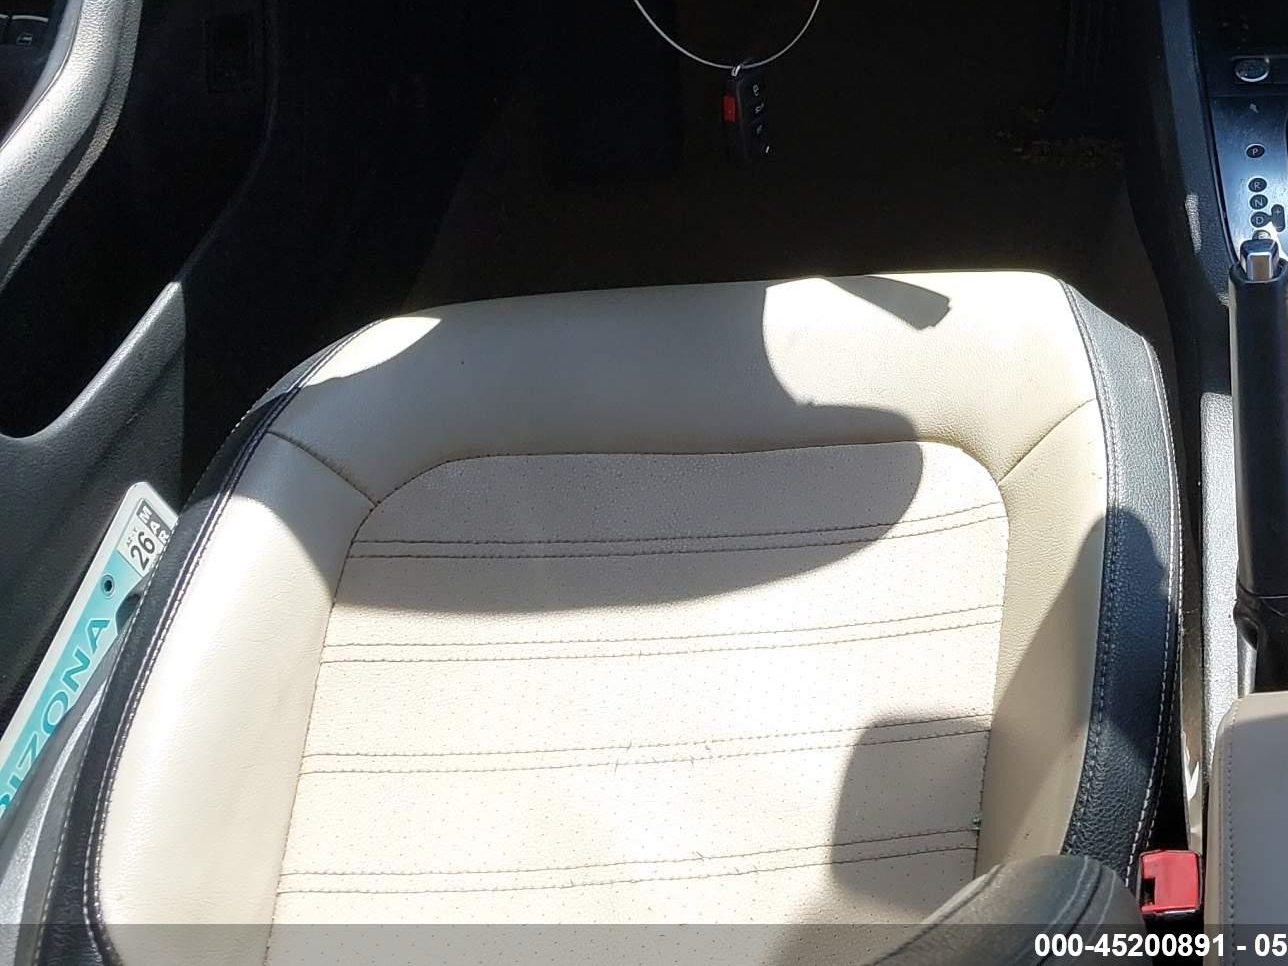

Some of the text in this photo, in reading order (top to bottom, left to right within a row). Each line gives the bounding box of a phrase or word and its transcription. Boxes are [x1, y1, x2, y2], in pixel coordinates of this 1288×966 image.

[1253, 181, 1261, 191] R
[1254, 198, 1263, 207] N
[1255, 216, 1264, 225] D
[130, 531, 155, 571] 26
